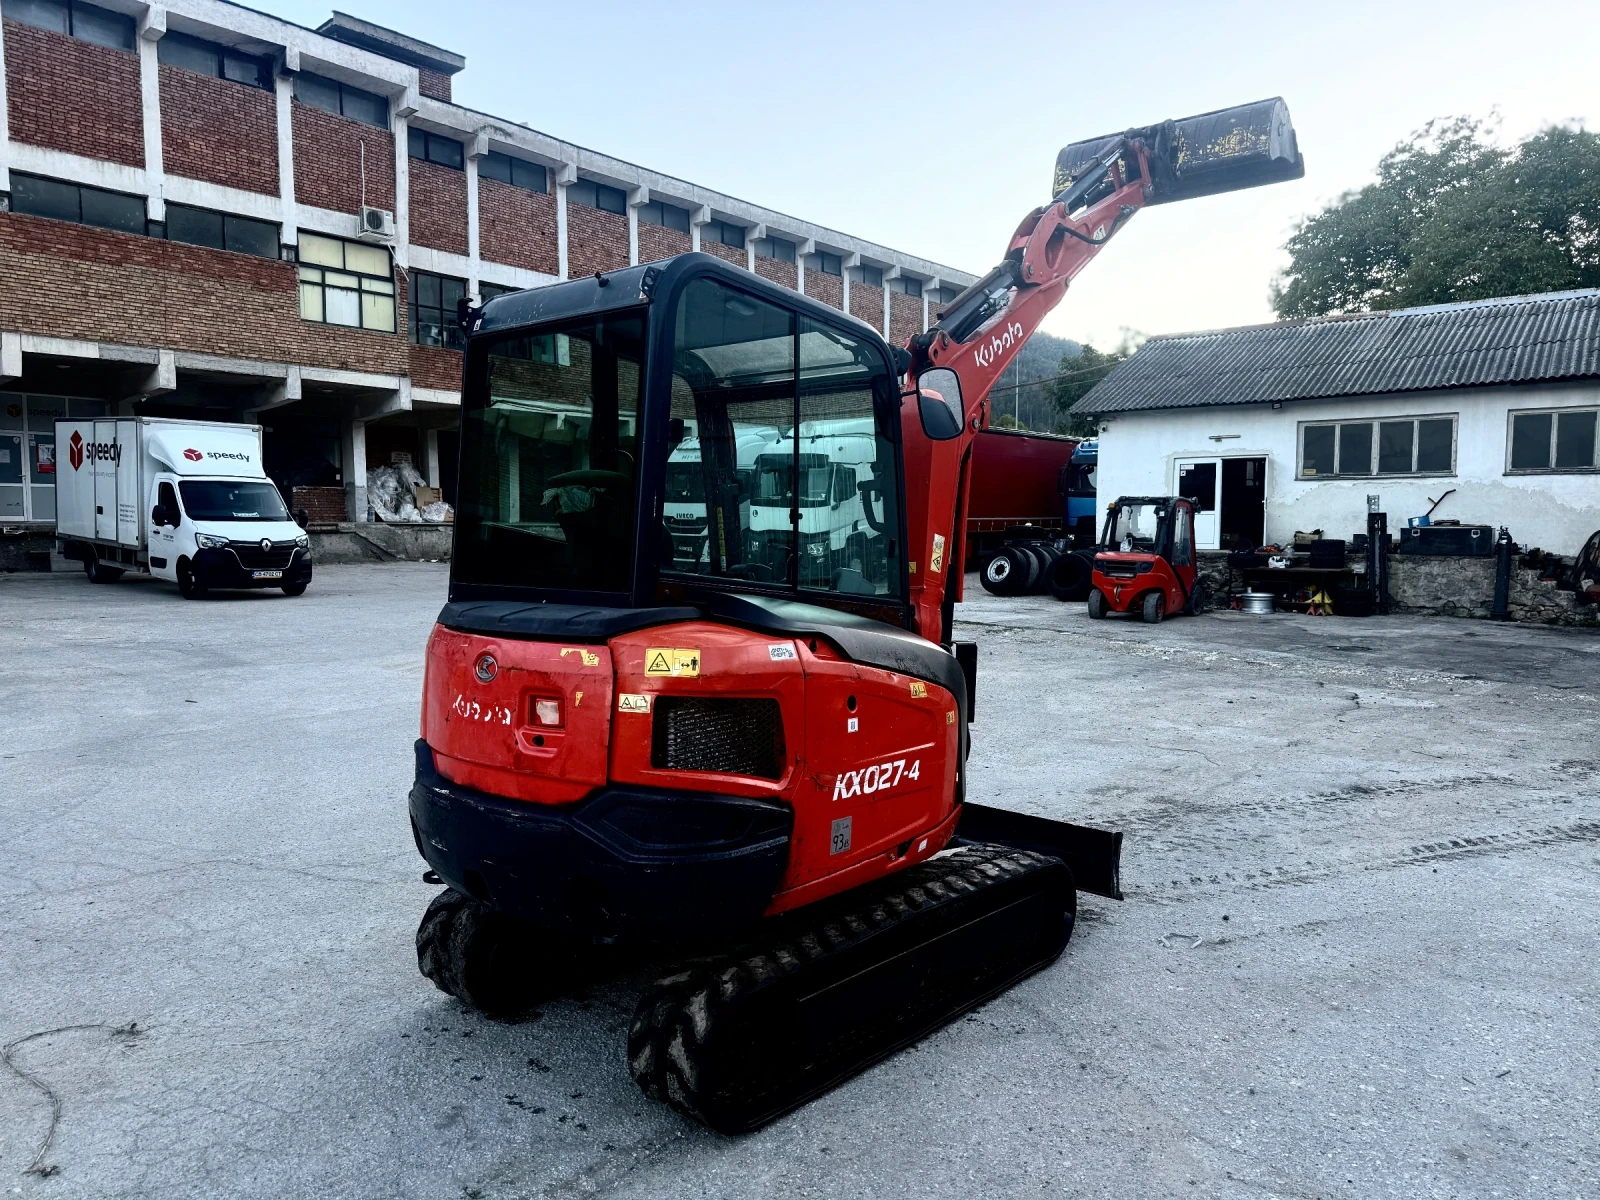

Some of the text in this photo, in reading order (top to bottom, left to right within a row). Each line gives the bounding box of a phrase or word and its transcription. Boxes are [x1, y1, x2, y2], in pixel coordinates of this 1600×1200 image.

[974, 322, 1024, 367] Kubota
[28, 408, 64, 418] speedy
[86, 437, 122, 467] speedy
[207, 452, 250, 462] speedy
[832, 759, 921, 802] KX027-4
